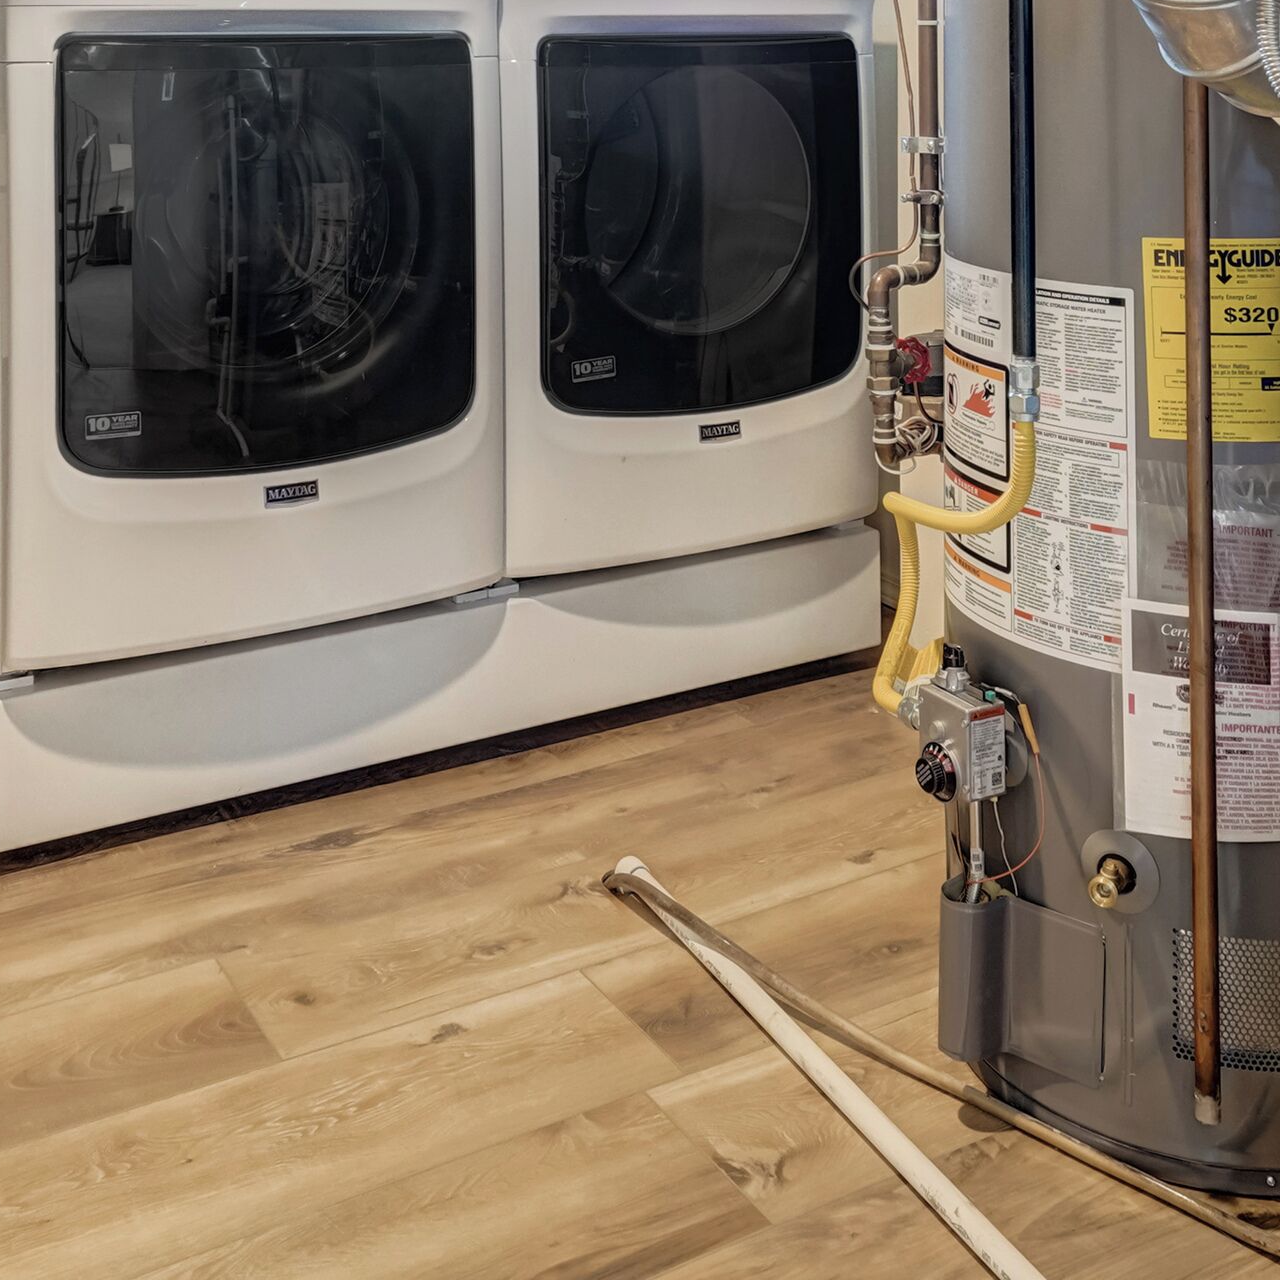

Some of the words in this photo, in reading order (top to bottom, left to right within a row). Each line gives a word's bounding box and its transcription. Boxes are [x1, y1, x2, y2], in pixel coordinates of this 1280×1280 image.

[1226, 293, 1244, 301] Energy
[1050, 302, 1070, 310] STORAGE
[1224, 307, 1280, 323] $320
[574, 362, 592, 376] 10
[592, 358, 613, 366] YEAR
[88, 417, 111, 432] 10
[111, 414, 138, 423] YEAR
[701, 423, 740, 438] MAYTAG
[267, 483, 316, 501] MAYTAG
[1219, 525, 1274, 538] IMPORTANT
[1221, 620, 1277, 633] IMPORTANT
[1227, 631, 1243, 646] of
